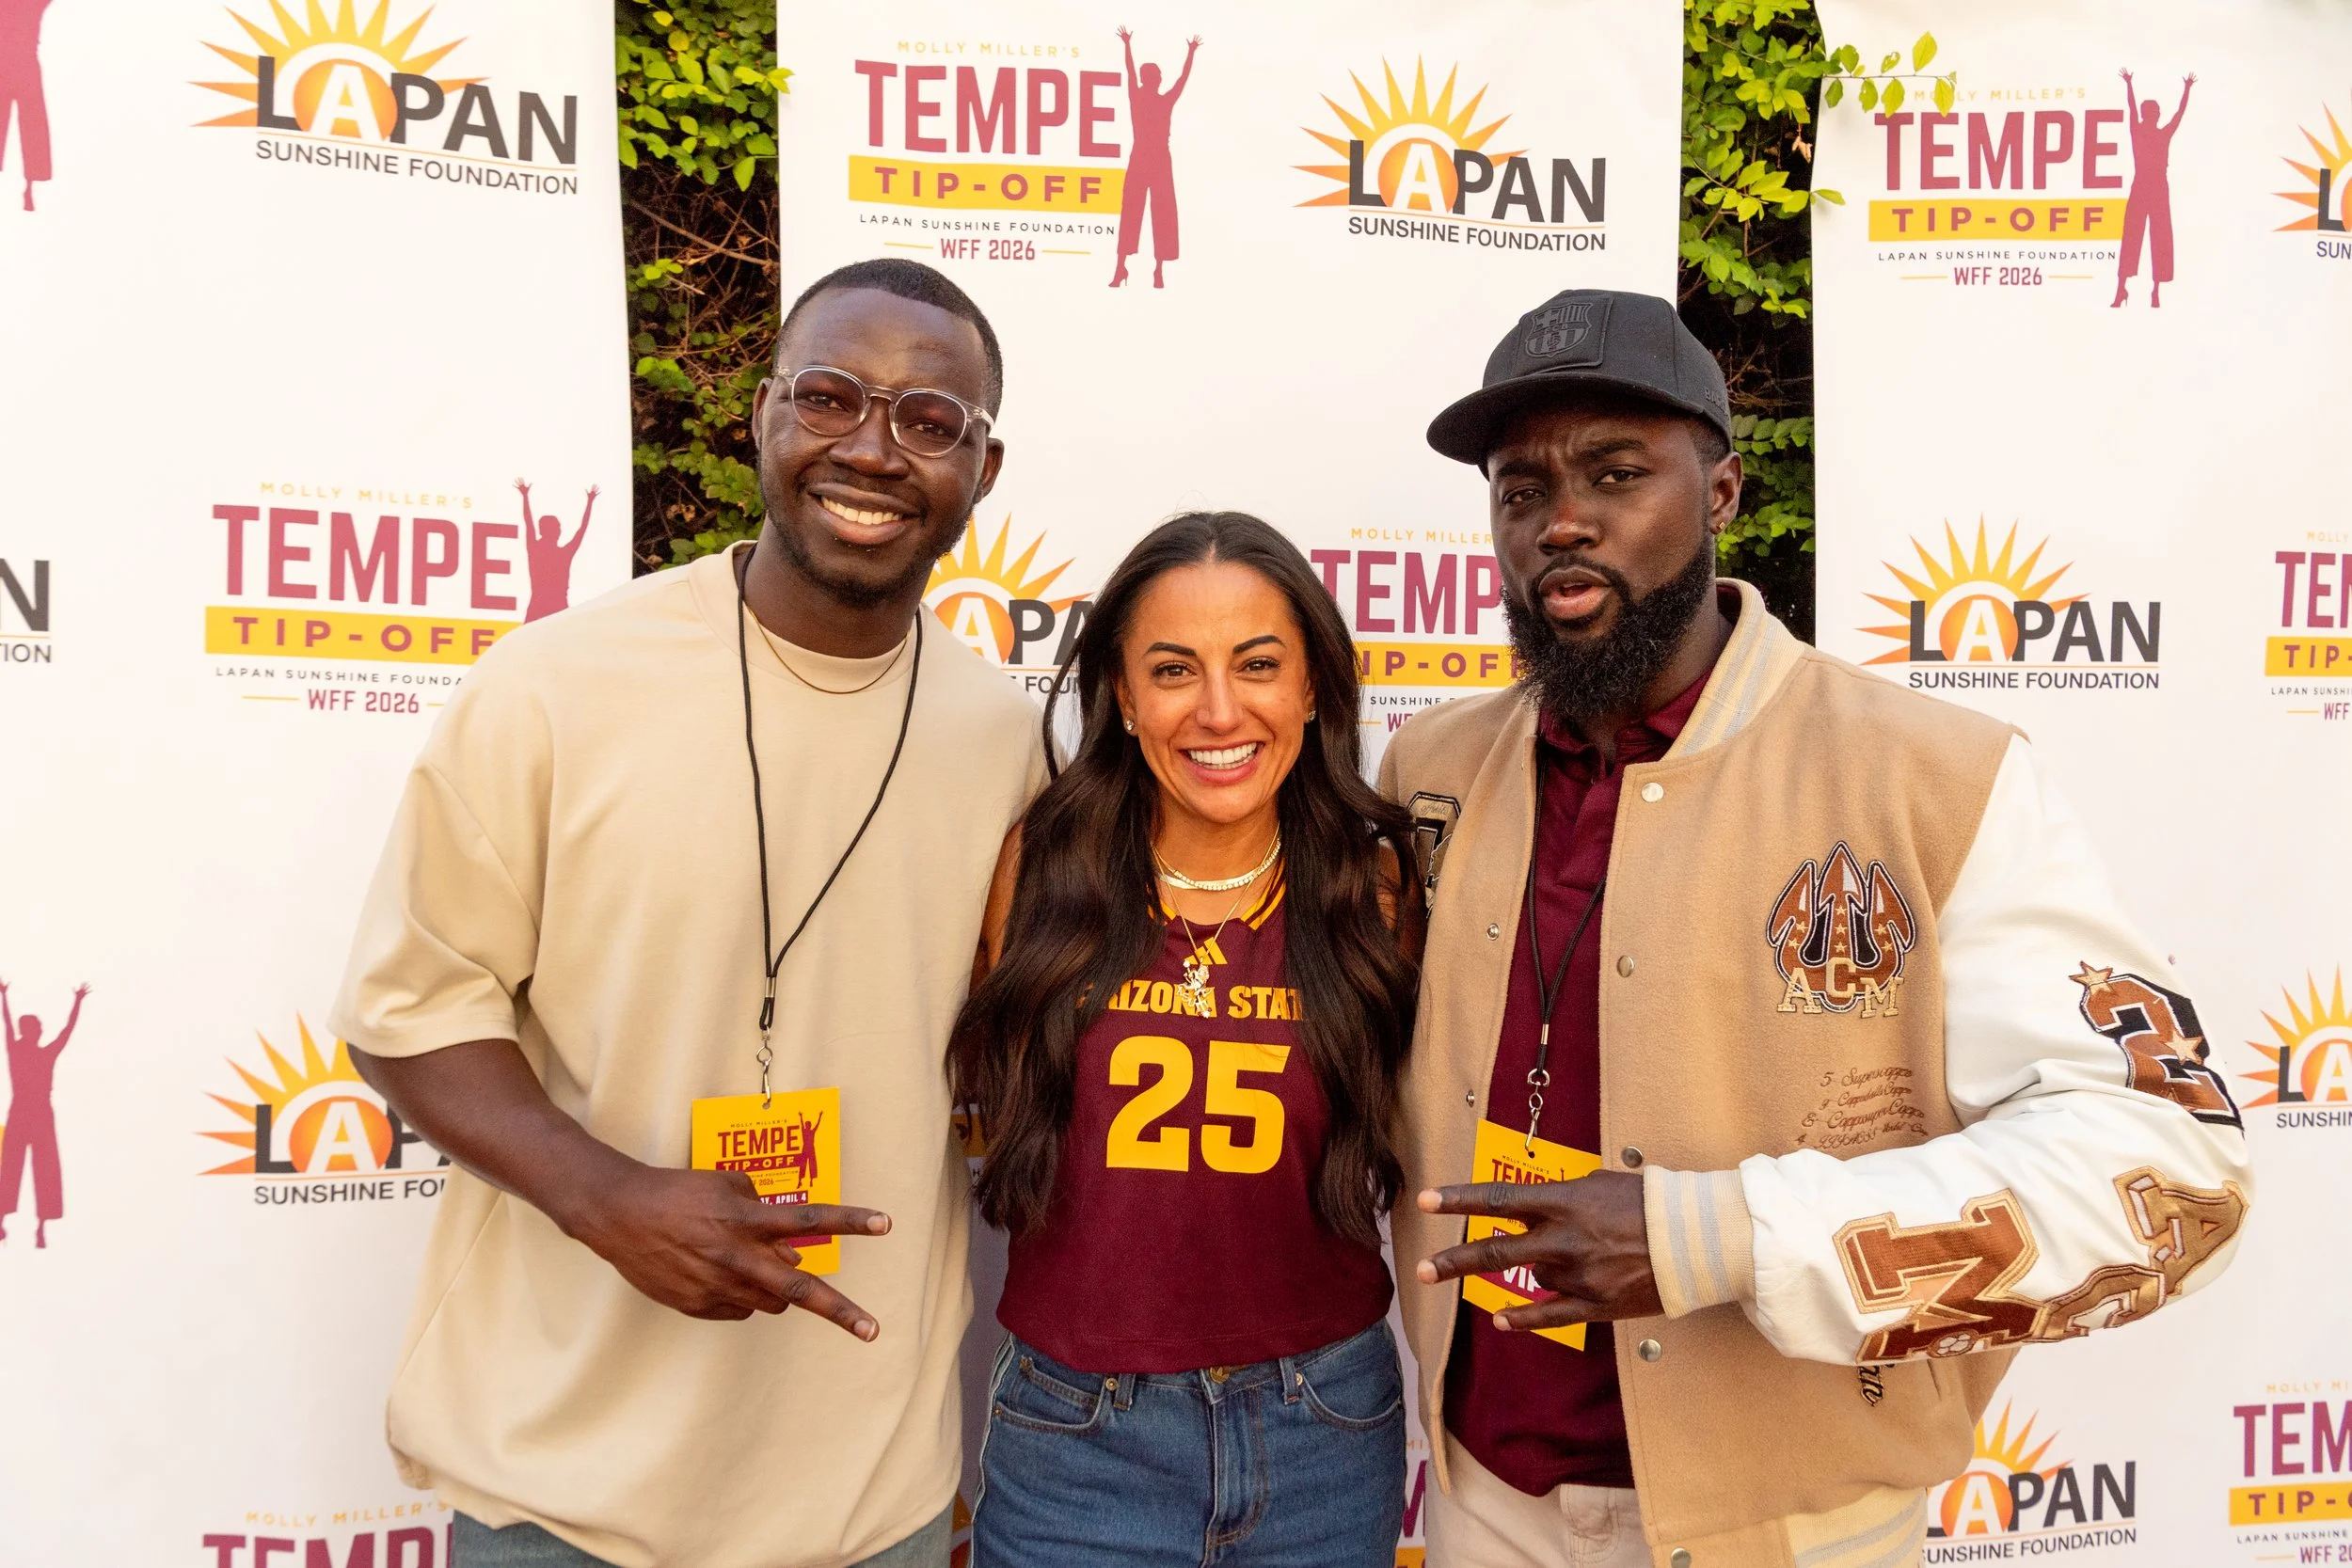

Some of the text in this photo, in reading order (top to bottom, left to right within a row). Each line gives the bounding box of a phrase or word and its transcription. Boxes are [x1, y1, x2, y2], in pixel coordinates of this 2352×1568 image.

[898, 40, 1081, 58] MOLLY MILLER'S
[1990, 87, 2086, 101] MILLER'S
[258, 55, 578, 165] LAPAN
[854, 59, 1122, 159] TEMPE
[1874, 109, 2124, 191] TEMPE
[256, 139, 579, 196] SUNSHINE FOUNDATION
[874, 166, 1103, 204] TIP-OFF
[1349, 139, 1607, 224] LAPAN
[859, 214, 1116, 236] LAPAN SUNSHINE FOUNDATION
[1891, 206, 2106, 233] TIP-OFF
[1348, 215, 1606, 252] SUNSHINE FOUNDATION
[941, 238, 1036, 261] WFF 2026
[1878, 250, 2116, 262] LAPAN SUNSHINE FOUNDATION
[1953, 266, 2042, 286] WFF 2026
[260, 482, 472, 509] MOLLY MILLER'S
[1351, 528, 1414, 541] MOLLY
[213, 504, 519, 611] TEMPE
[2275, 550, 2352, 628] TE
[232, 616, 495, 656] TIP-OFF
[1909, 600, 2162, 662] LAPAN
[0, 642, 52, 663] ION
[215, 667, 277, 679] LAPAN
[286, 669, 382, 683] SUNSHINE
[1909, 671, 2160, 689] SUNSHINE FOUNDATION
[309, 689, 420, 714] WFF 2026
[2271, 687, 2308, 695] LAPAN
[2324, 702, 2351, 721] WFF
[1106, 1035, 1292, 1174] 25
[2276, 1111, 2352, 1129] SUNSHI
[718, 1125, 801, 1158] TEMPE
[723, 1156, 795, 1171] TIP-OFF
[254, 1180, 395, 1205] SUNSHINE
[758, 1178, 774, 1186] 2026
[775, 1193, 799, 1204] APRIL
[801, 1192, 807, 1201] 4
[1927, 1461, 2137, 1538] APAN
[246, 1511, 317, 1528] MOLLY
[2020, 1528, 2137, 1557] FOUNDATION
[2236, 1528, 2349, 1544] LAPAN SUNSHINE
[2299, 1544, 2333, 1564] WFF
